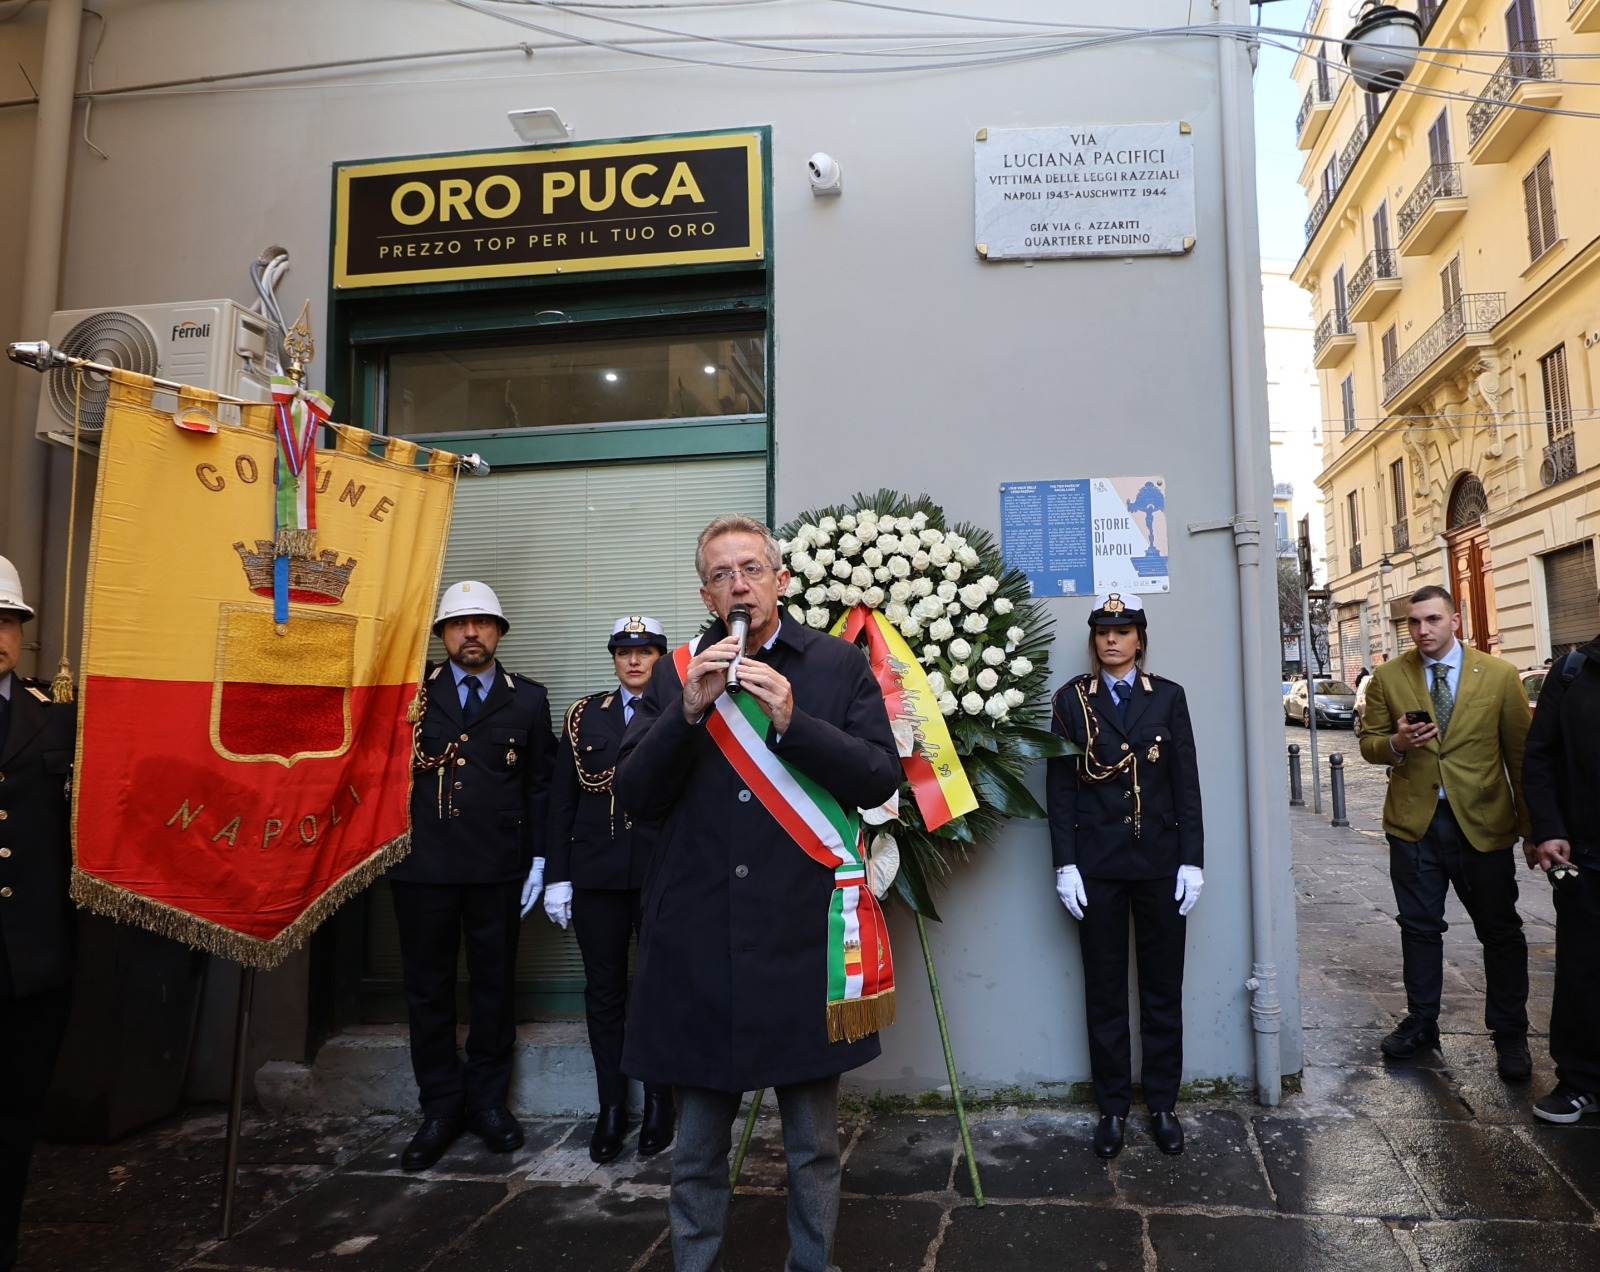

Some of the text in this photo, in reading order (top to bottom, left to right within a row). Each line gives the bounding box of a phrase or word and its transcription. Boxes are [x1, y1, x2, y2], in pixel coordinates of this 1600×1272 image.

[1070, 133, 1097, 146] VIA
[1003, 149, 1165, 168] LUCIANA PACIFICI
[989, 169, 1179, 185] VITTIMA DELLE LEGGI RAZZIALI
[391, 161, 705, 226] ORO PUCA
[1004, 191, 1041, 201] NAPOLI
[1142, 187, 1167, 197] 1944
[1052, 222, 1071, 231] VIA
[1088, 220, 1140, 230] AZZARITI
[379, 222, 715, 259] PREZZO TOP PER IL TUO ORO
[1024, 233, 1151, 247] QUARTIERE PENDINO
[171, 323, 211, 342] Ferroli
[195, 453, 395, 523] COUNE
[1094, 517, 1130, 530] STORIE
[1094, 531, 1105, 543] DI
[1095, 543, 1132, 556] NAPOLI
[165, 785, 361, 848] NAPOLI
